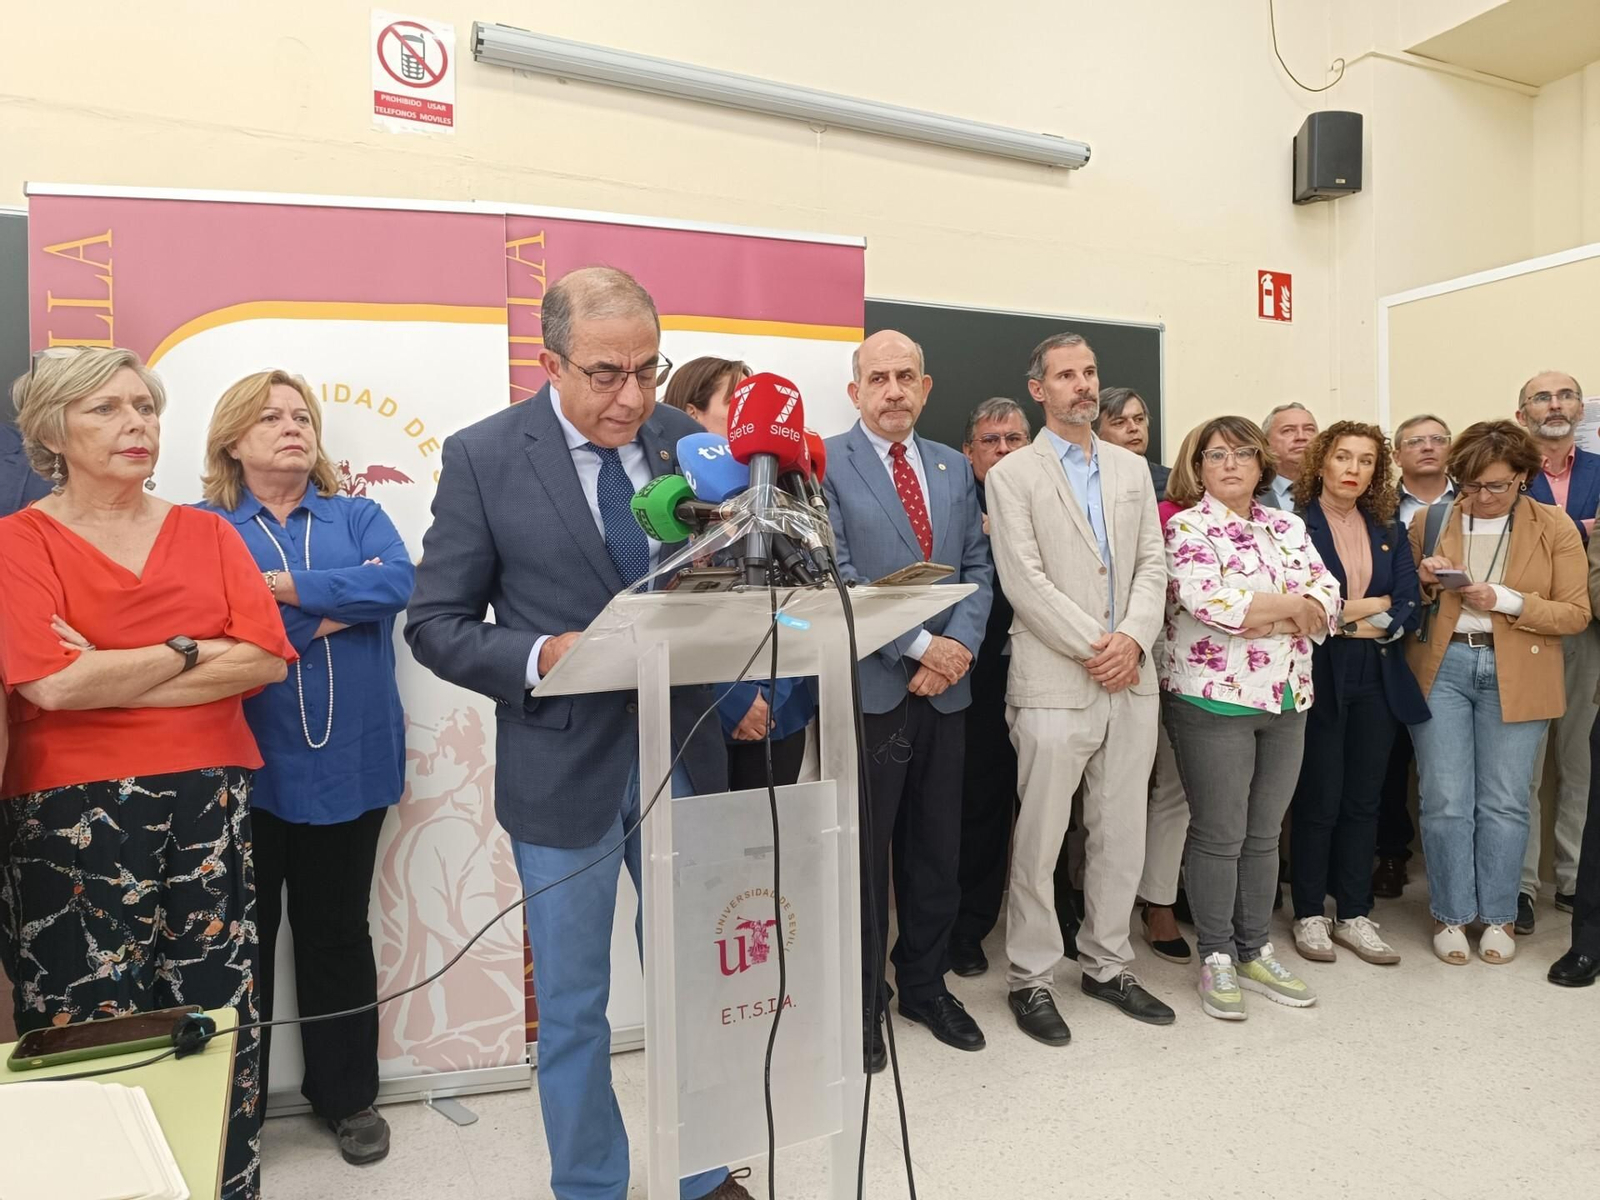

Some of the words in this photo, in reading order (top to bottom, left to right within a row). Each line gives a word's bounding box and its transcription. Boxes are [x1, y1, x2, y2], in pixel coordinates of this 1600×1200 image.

[375, 105, 417, 119] TELEFONOS
[419, 113, 452, 125] MOVILES
[380, 94, 422, 107] PROHIBIDO
[427, 102, 447, 111] USAR
[42, 228, 114, 348] LLA
[322, 383, 398, 418] IDAD
[403, 418, 441, 458] DE
[769, 424, 801, 442] siete
[721, 994, 797, 1026] E.T.S.IA.
